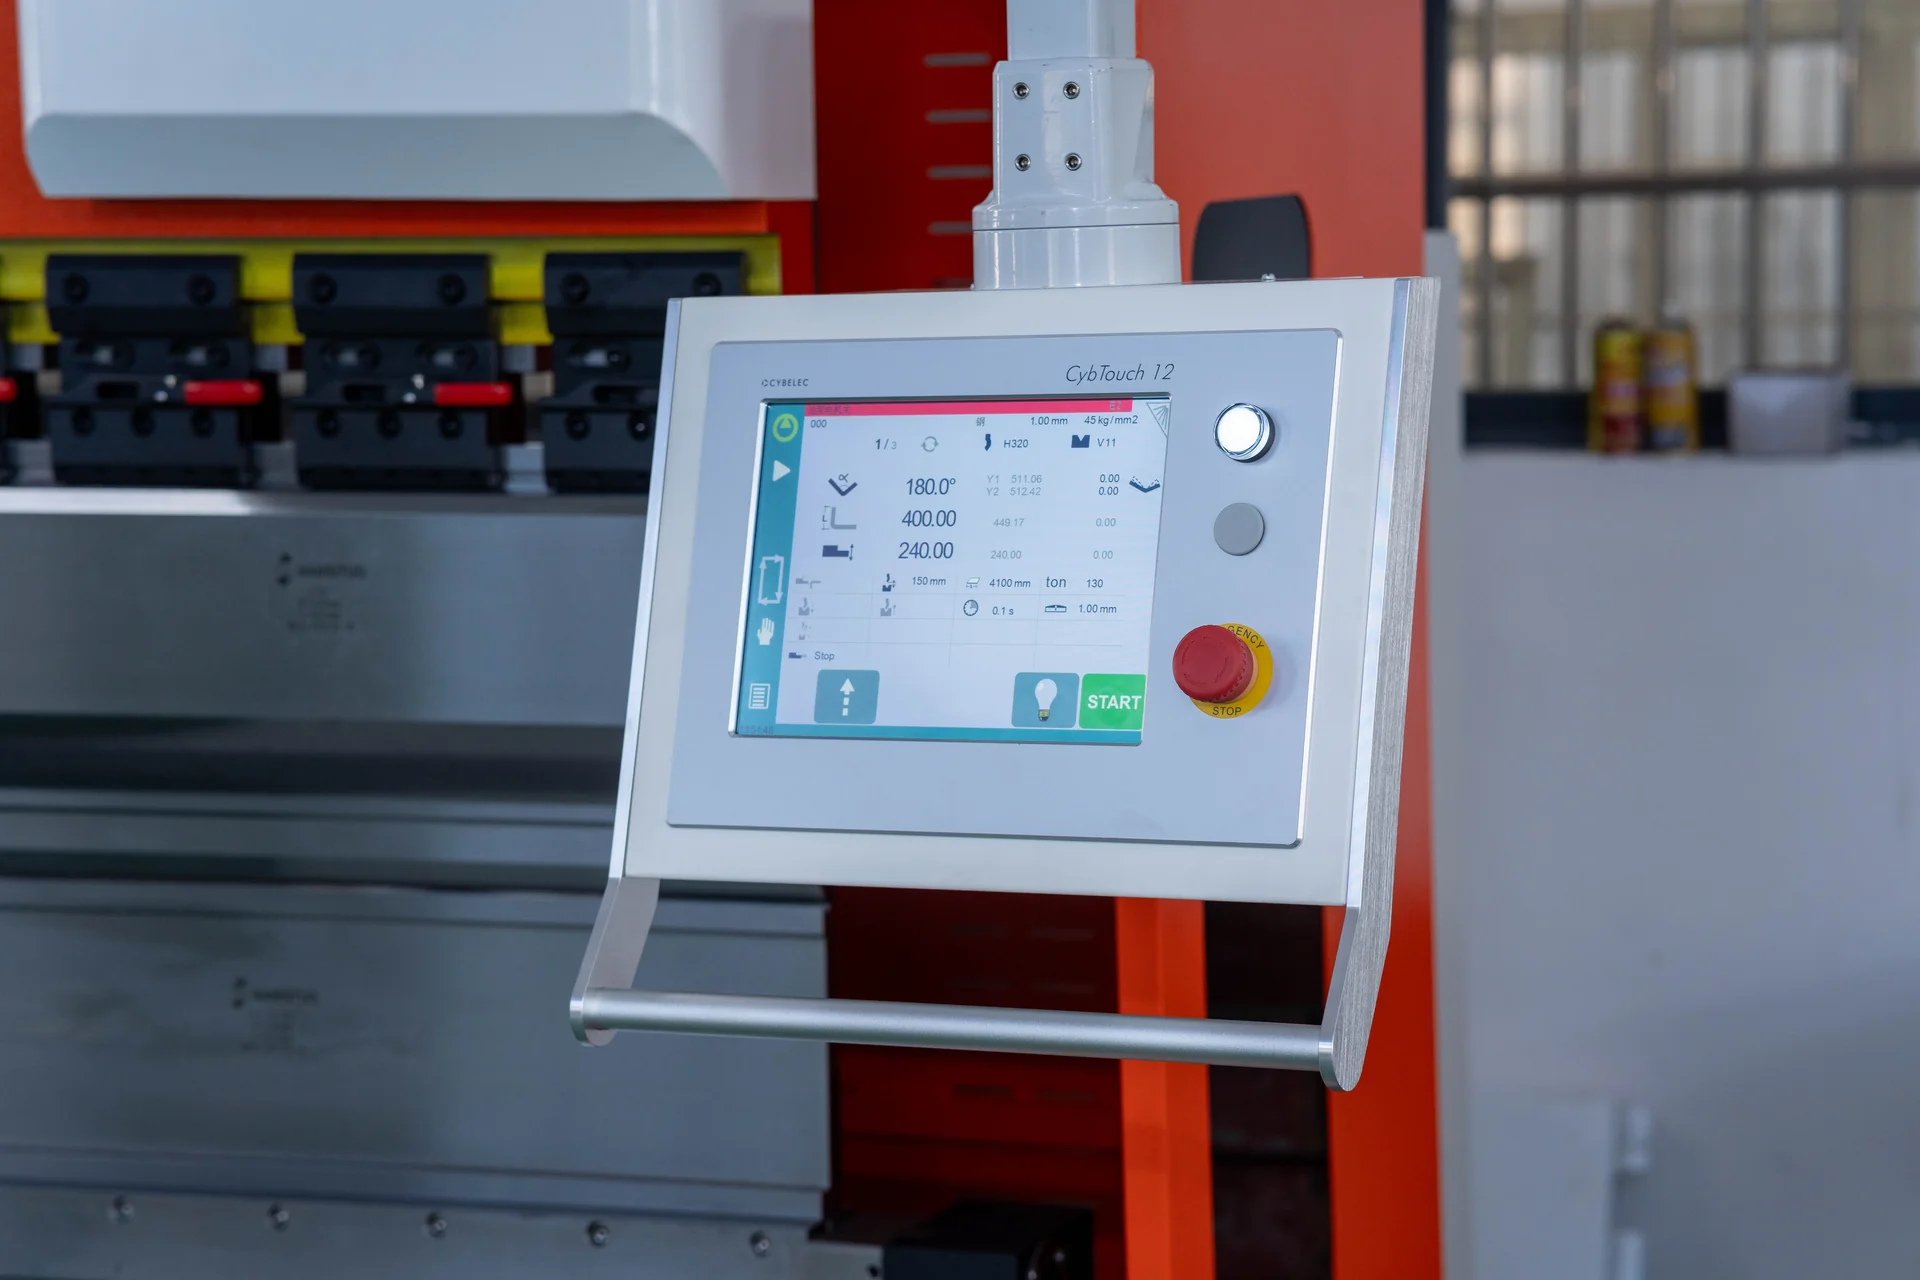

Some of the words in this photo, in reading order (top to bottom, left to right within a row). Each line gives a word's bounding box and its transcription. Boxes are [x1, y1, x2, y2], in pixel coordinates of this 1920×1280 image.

[1066, 364, 1144, 386] CybTouch
[1154, 363, 1175, 380] 12
[769, 378, 809, 387] CYBELEC
[810, 420, 828, 429] 000
[1031, 417, 1049, 425] 1.00
[1084, 416, 1096, 424] 45
[1004, 439, 1028, 448] H320
[1097, 438, 1116, 447] V11
[986, 475, 999, 484] Y1
[1011, 475, 1042, 484] 511.06
[1100, 474, 1120, 483] 0.00
[986, 487, 999, 496] Y2
[1010, 487, 1041, 496] 512.42
[1099, 486, 1119, 495] 0.00
[902, 510, 956, 527] 400.00
[993, 518, 1024, 527] 449.17
[1096, 518, 1116, 527] 0.00
[898, 542, 954, 559] 240.00
[990, 551, 1022, 559] 240.00
[1093, 551, 1113, 559] 0.00
[912, 577, 928, 585] 150
[989, 579, 1013, 587] 4100
[1046, 576, 1067, 588] ton
[1086, 579, 1103, 588] 130
[992, 606, 1006, 615] 0.1
[1078, 604, 1099, 613] 1.00
[1100, 605, 1117, 613] mm
[814, 651, 835, 662] Stop
[1087, 694, 1142, 710] START
[1212, 706, 1242, 716] STOP
